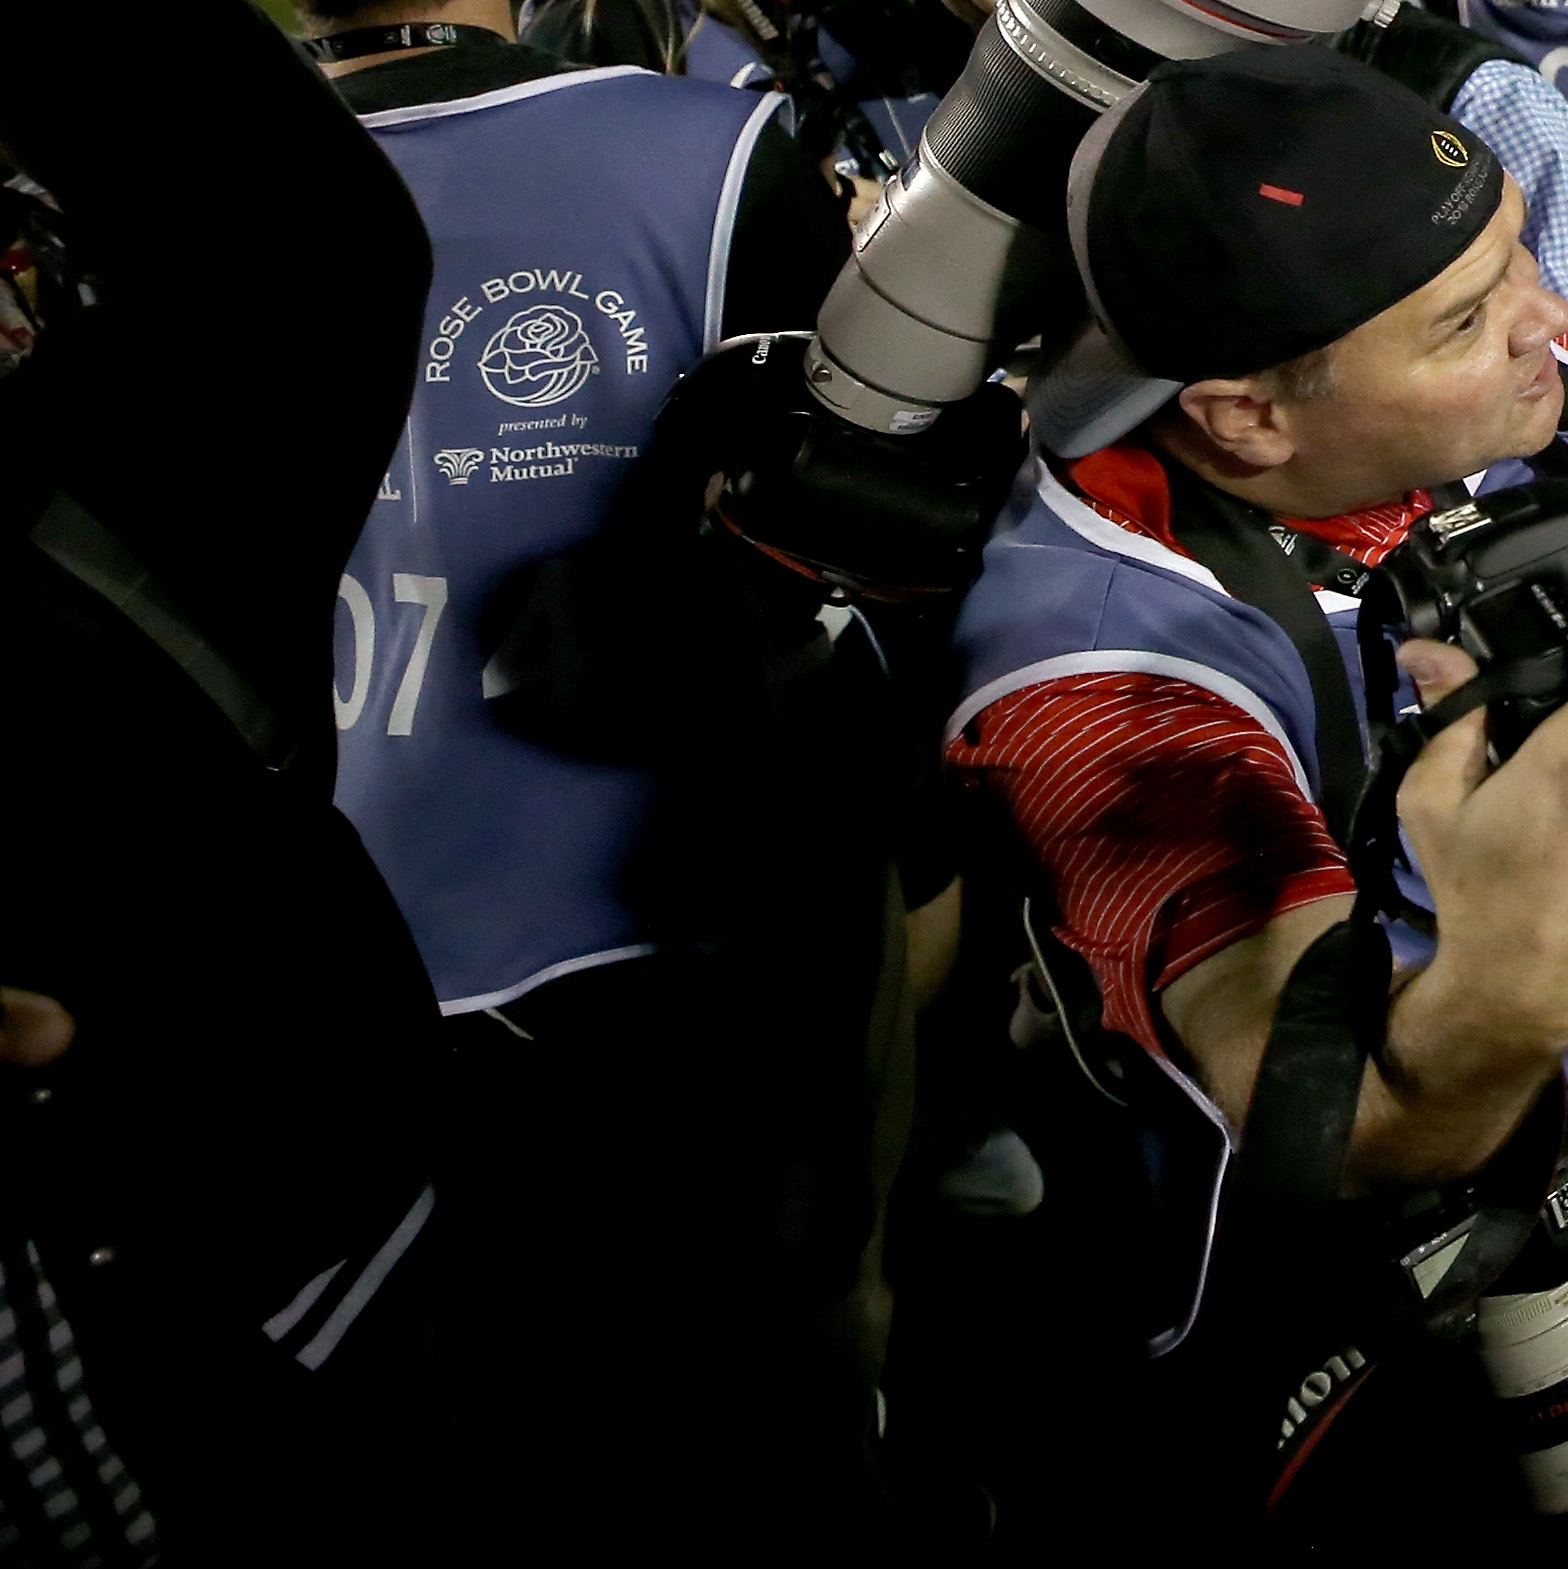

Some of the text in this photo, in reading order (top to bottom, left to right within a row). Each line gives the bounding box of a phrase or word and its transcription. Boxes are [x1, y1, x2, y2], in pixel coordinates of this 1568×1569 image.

[426, 268, 649, 384] ROSE BOWL GAME
[498, 413, 588, 437] presented by
[489, 442, 639, 465] Northwestern
[489, 459, 576, 483] Mutual
